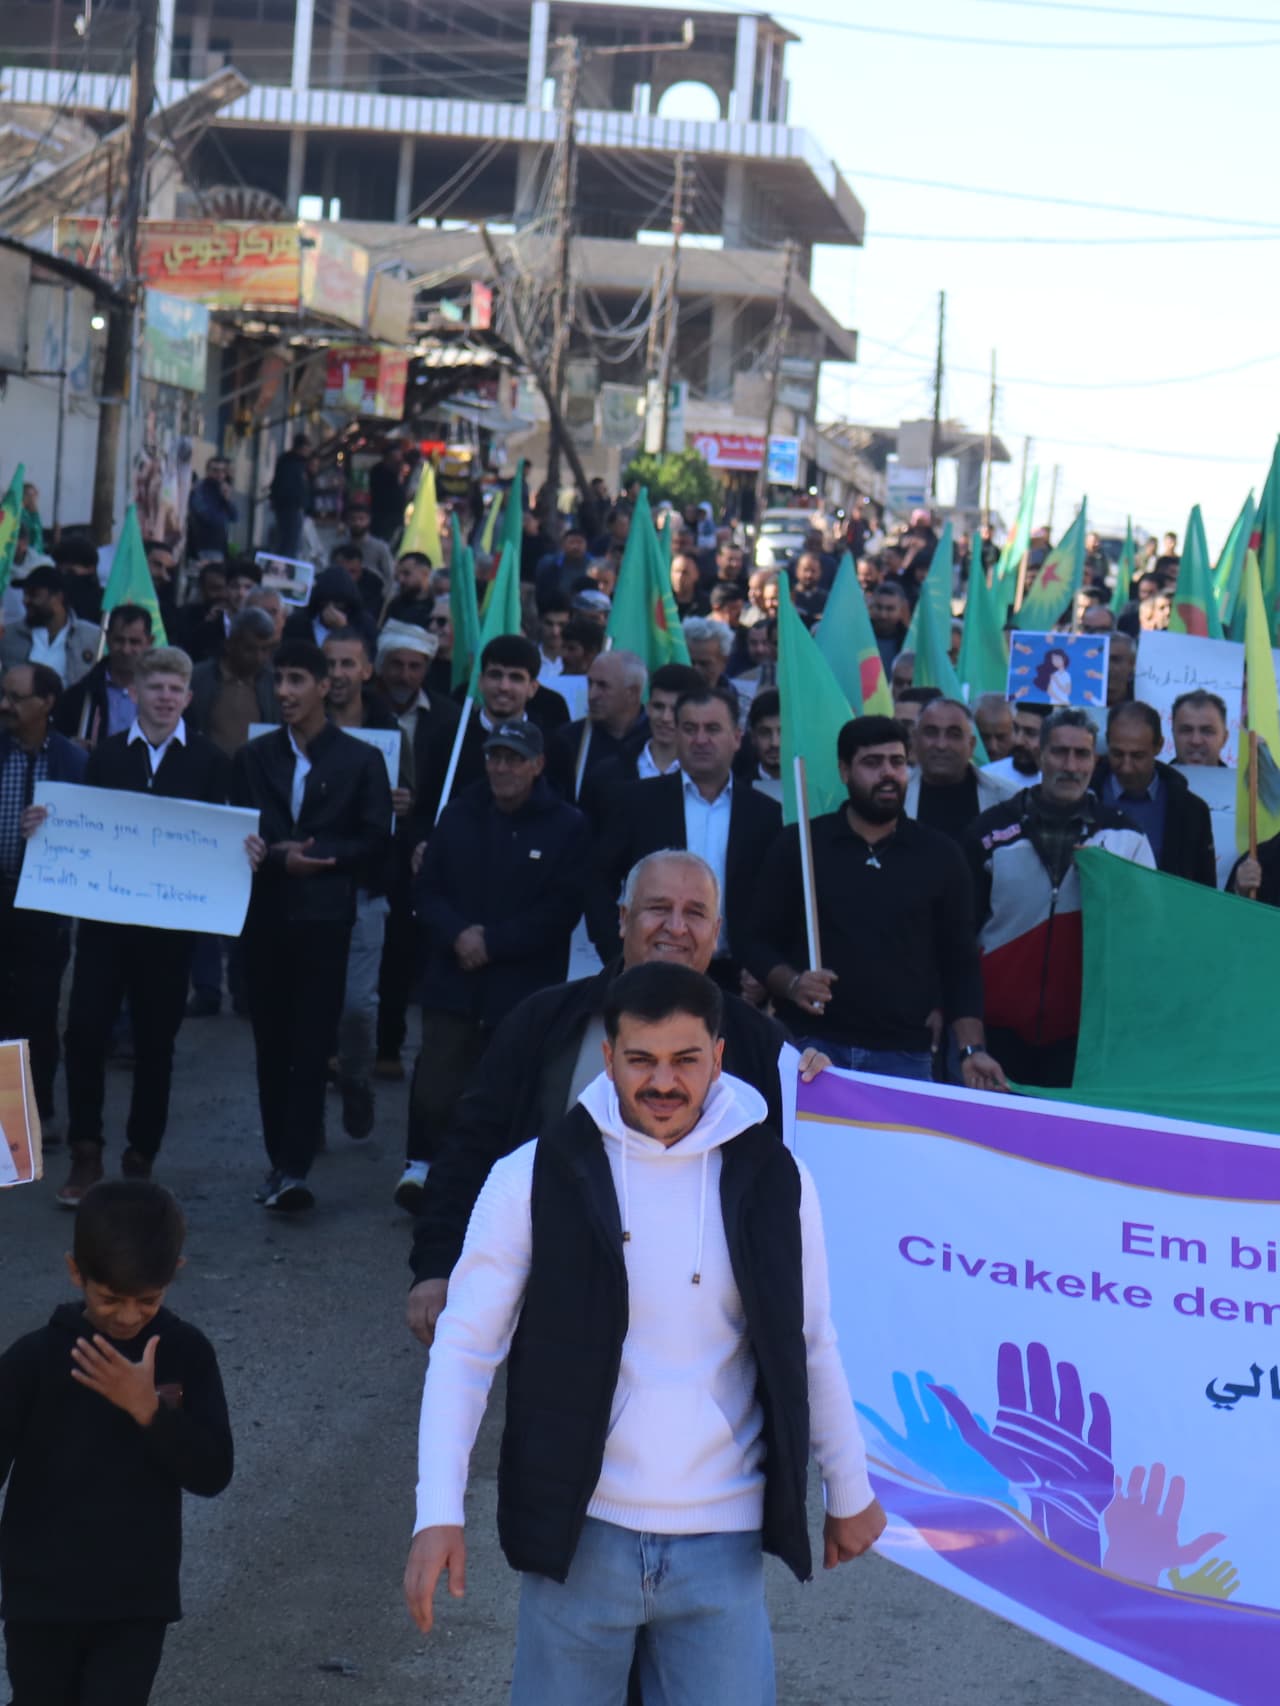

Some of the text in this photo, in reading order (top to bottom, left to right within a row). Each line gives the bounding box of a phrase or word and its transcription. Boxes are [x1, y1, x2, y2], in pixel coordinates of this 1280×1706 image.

[898, 1235, 1152, 1308] Civakeke
[1122, 1221, 1207, 1264] Em
[1231, 1236, 1276, 1273] bi
